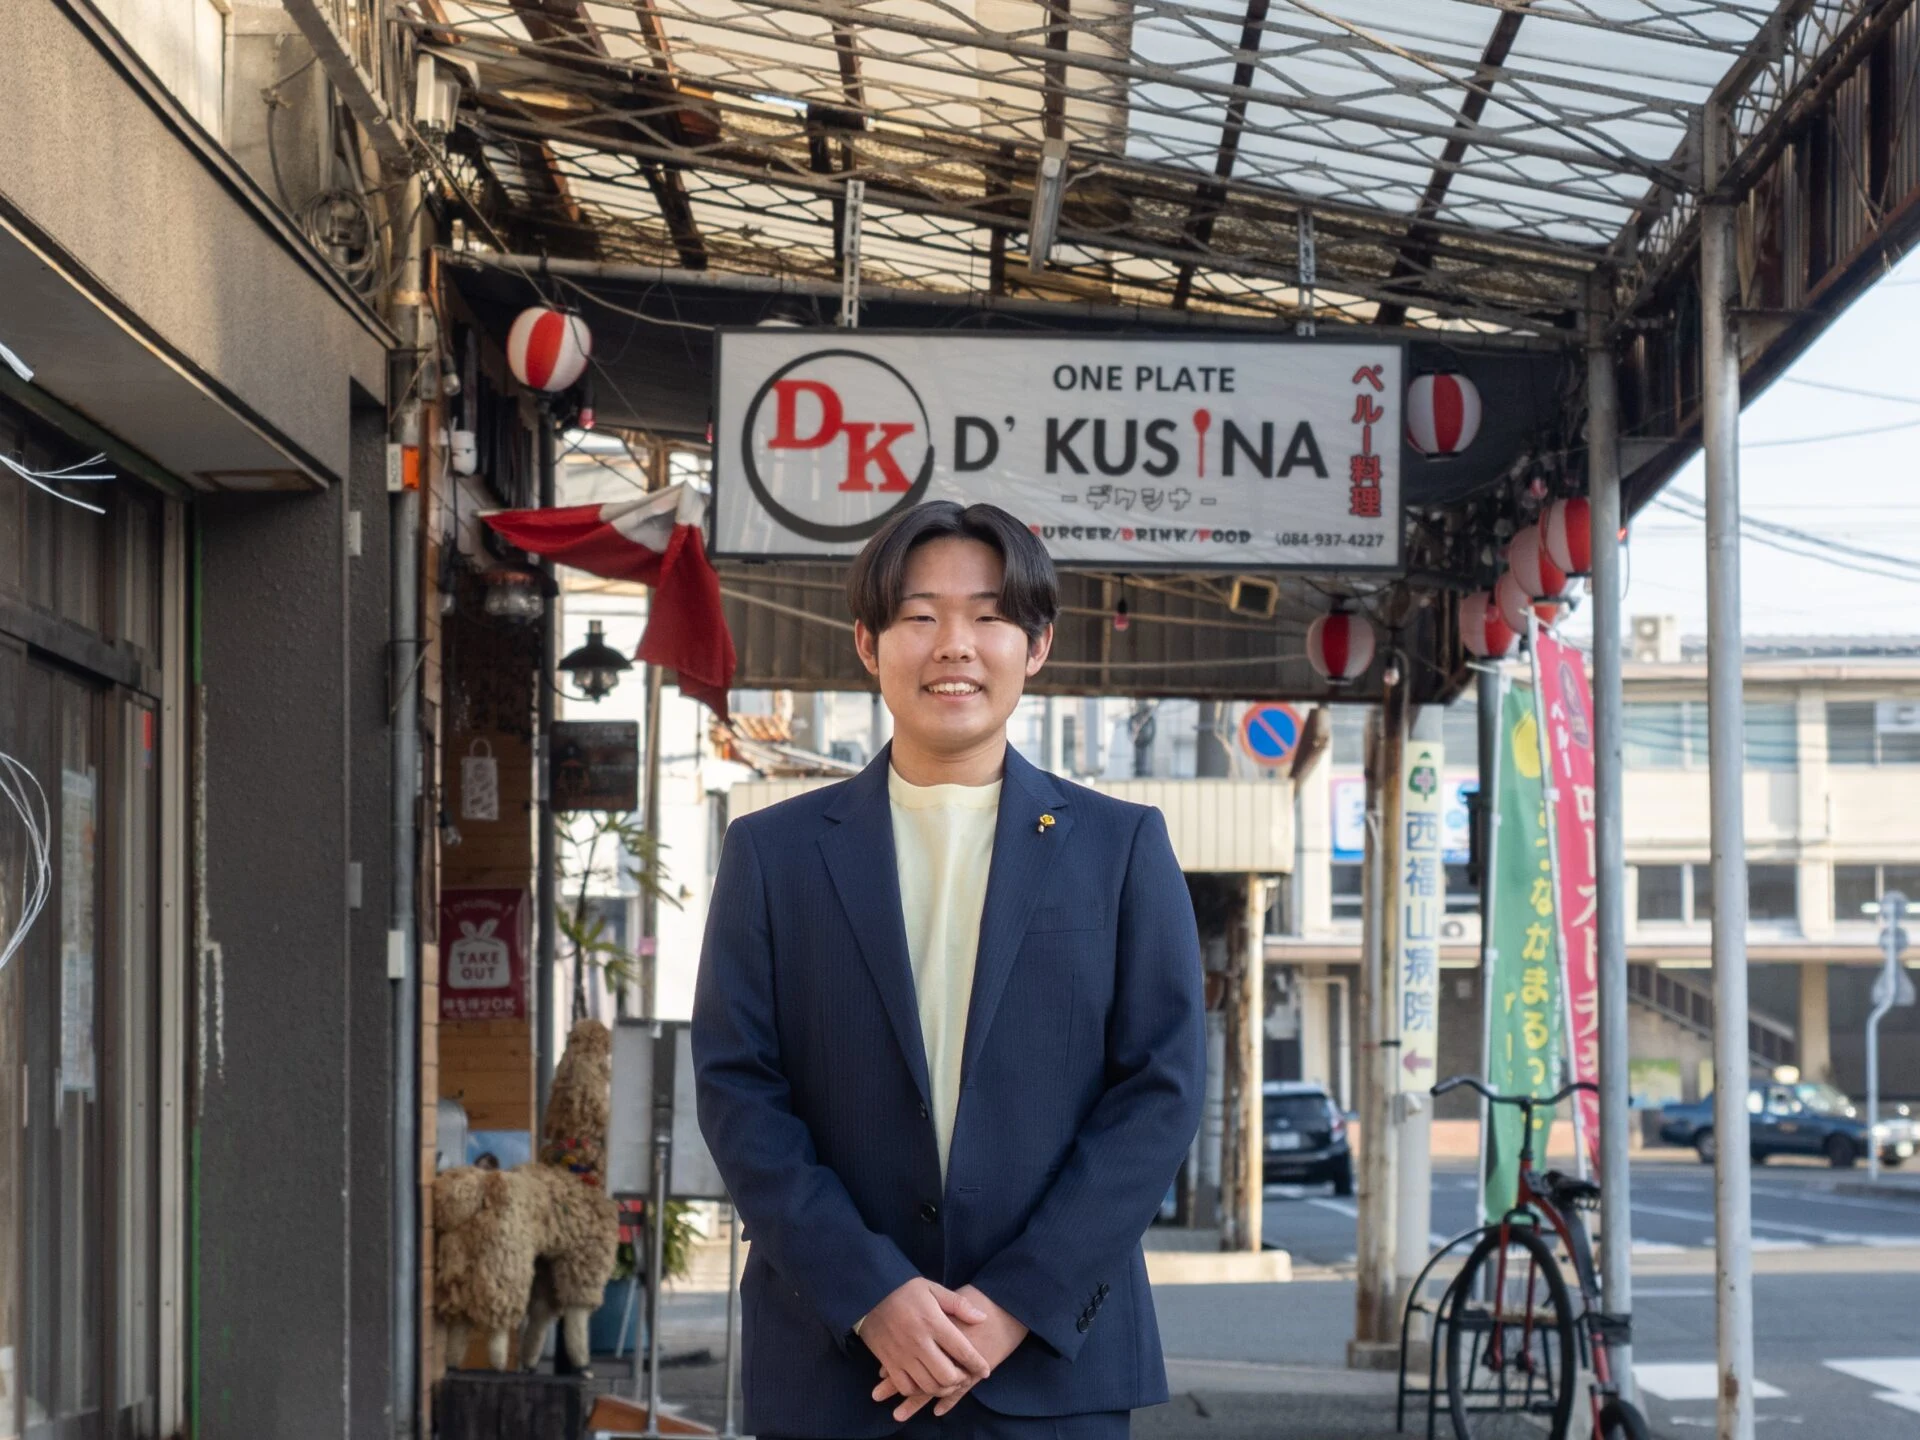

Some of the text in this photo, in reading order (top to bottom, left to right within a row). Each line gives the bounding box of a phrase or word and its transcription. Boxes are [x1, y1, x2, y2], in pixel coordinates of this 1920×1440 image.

[1053, 364, 1236, 394] ONE PLATE
[1044, 408, 1330, 479] KUSINA
[1349, 364, 1385, 518] ペルー料理
[1404, 811, 1438, 1031] 西福山病院
[457, 950, 500, 965] TAKE
[461, 967, 497, 980] OUT
